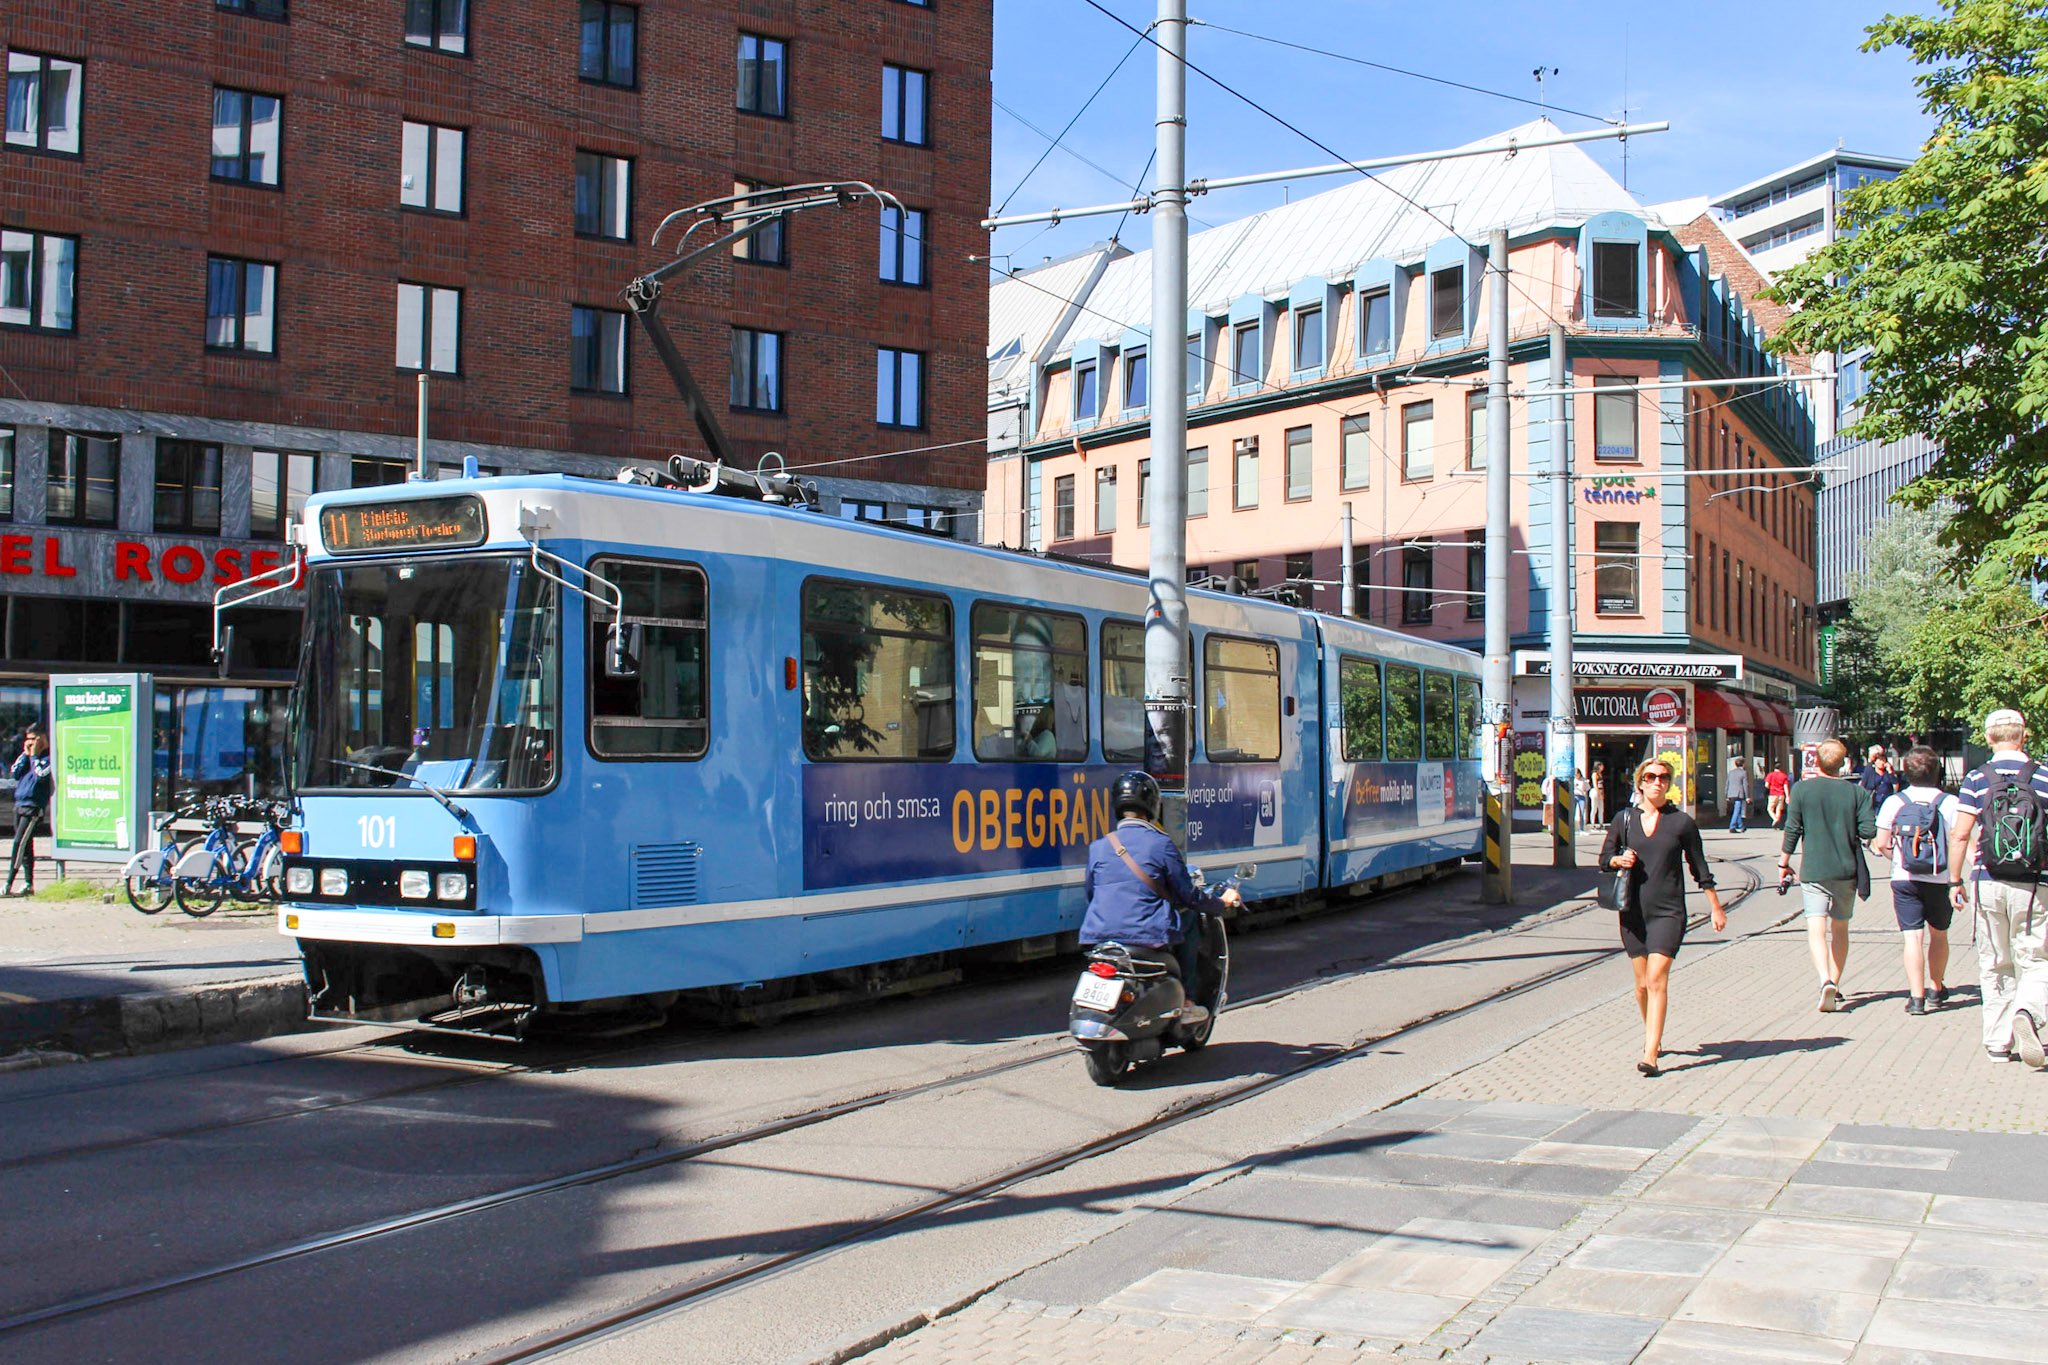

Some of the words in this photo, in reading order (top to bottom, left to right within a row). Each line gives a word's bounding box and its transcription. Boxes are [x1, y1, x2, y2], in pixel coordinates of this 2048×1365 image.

[1584, 487, 1643, 505] tenner
[330, 513, 349, 546] 11
[0, 535, 76, 577] EL
[1825, 633, 1833, 685] brilleland
[1572, 663, 1618, 675] VOKSNE
[1619, 664, 1637, 676] OG
[1639, 664, 1674, 676] UNGE
[1675, 665, 1722, 677] DAMER»
[65, 691, 122, 705] marked.no
[1581, 696, 1640, 717] VICTORIA
[1649, 702, 1675, 711] FACTORY
[1649, 709, 1677, 719] OUTLET!
[67, 755, 96, 772] Spar
[99, 755, 121, 770] tid.
[67, 787, 93, 799] levert
[1218, 783, 1233, 803] och
[1380, 779, 1400, 803] mobile
[1401, 779, 1414, 806] plan
[1521, 794, 1530, 802] 70
[824, 793, 858, 827] ring
[864, 792, 892, 820] och
[897, 797, 941, 818] sms:a
[952, 772, 1109, 854] OBEGRÄN
[357, 814, 396, 849] 101
